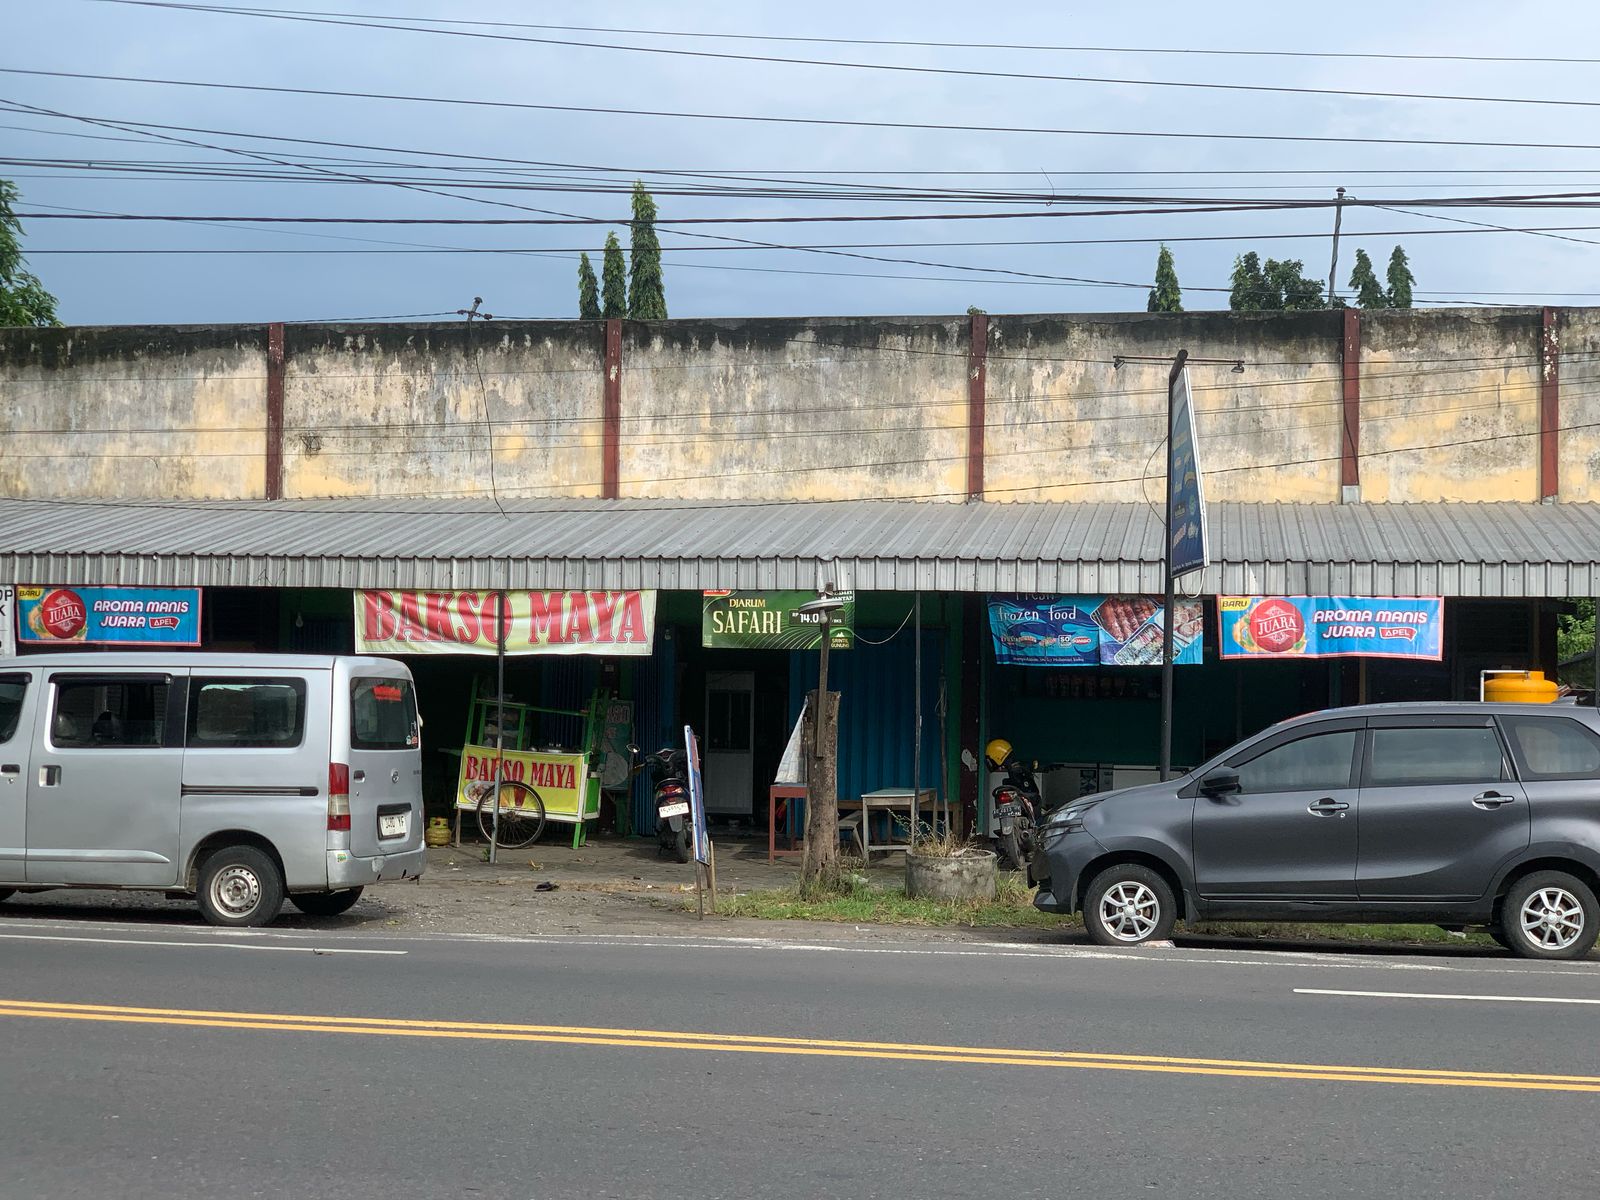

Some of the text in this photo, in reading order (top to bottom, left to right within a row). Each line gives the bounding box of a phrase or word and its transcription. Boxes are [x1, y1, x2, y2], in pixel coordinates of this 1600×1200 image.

[94, 600, 189, 613] AROMA MANIS
[729, 598, 766, 609] DJARUM
[1222, 599, 1248, 608] BARU
[49, 606, 81, 623] JUARA
[364, 590, 647, 644] BAKSO MAYA
[998, 603, 1077, 621] frozen food
[1313, 609, 1428, 623] AROMA MANIS
[100, 616, 174, 629] JUARA APEL
[712, 610, 782, 635] SAFARI
[1258, 615, 1297, 636] JUARA
[1322, 625, 1410, 639] JUARA APEL
[529, 761, 577, 790] MAYA
